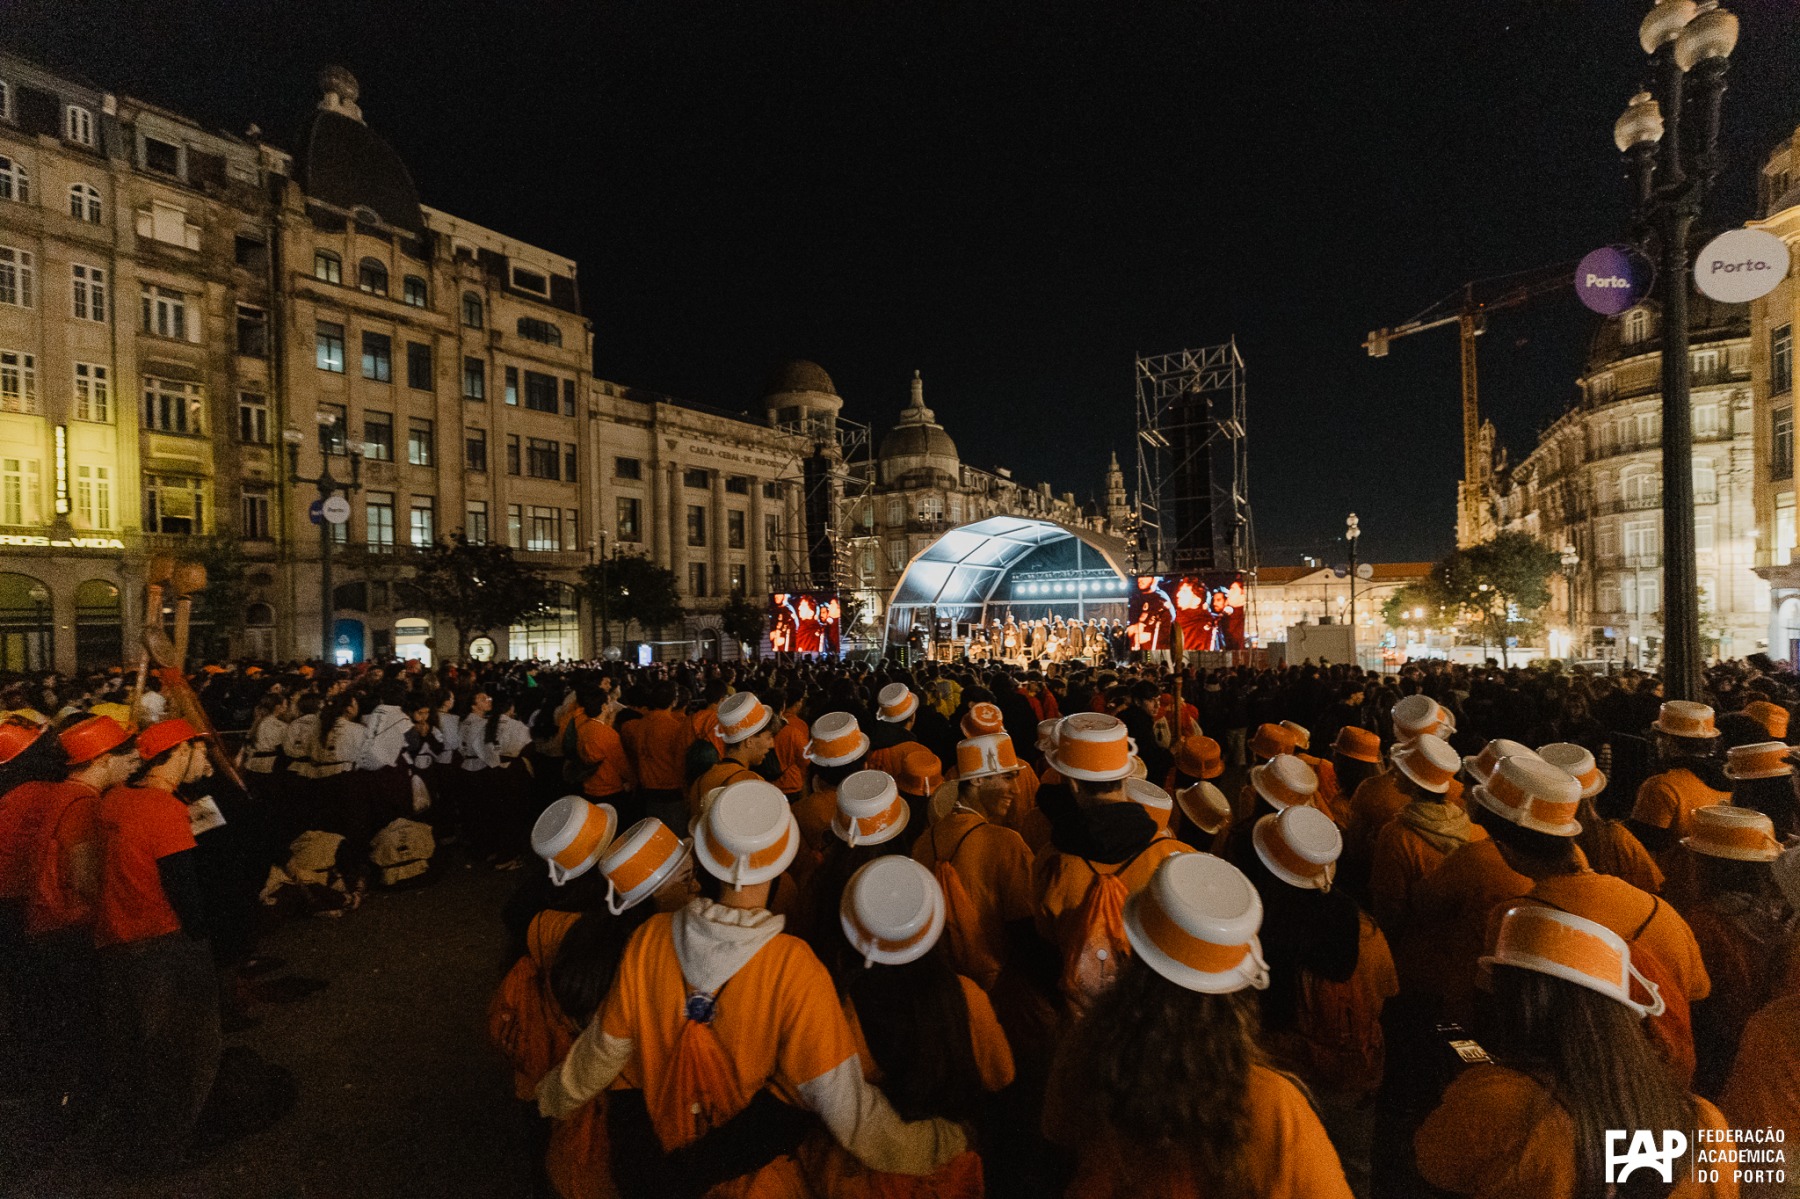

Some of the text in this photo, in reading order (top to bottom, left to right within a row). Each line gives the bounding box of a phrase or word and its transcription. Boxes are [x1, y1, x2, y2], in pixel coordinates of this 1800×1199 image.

[1711, 259, 1772, 274] Porto.
[1586, 274, 1631, 288] Porto.
[70, 537, 125, 549] VIDA
